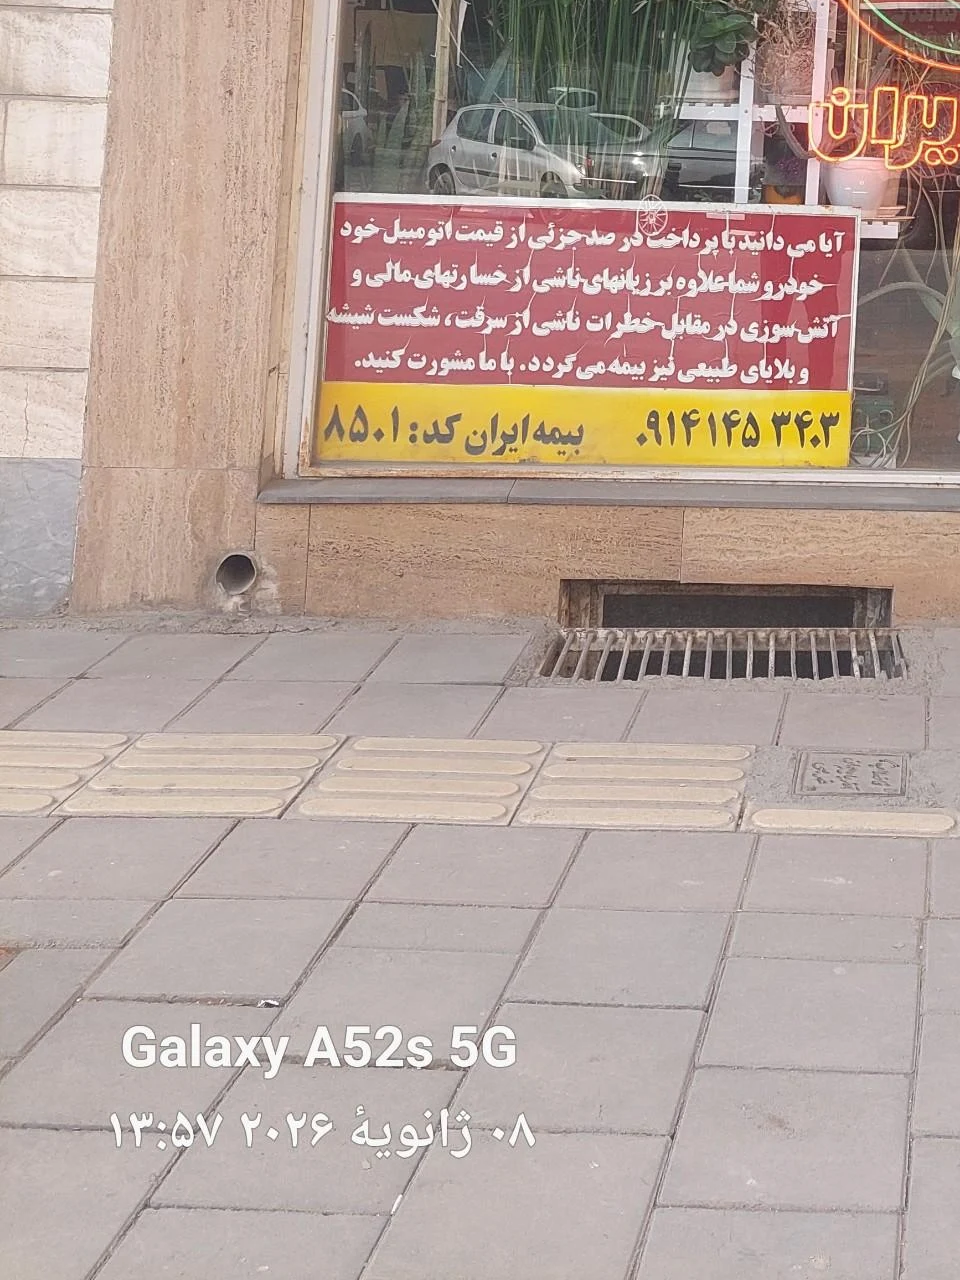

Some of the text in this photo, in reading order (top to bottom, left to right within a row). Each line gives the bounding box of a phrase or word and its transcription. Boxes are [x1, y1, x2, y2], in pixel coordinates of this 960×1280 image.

[339, 218, 381, 244] خود
[383, 217, 454, 249] اتومبیل
[454, 220, 504, 249] قیمت
[505, 218, 527, 250] از
[618, 229, 644, 253] در
[721, 226, 738, 256] با
[738, 228, 785, 257] دانید
[818, 230, 846, 258] آیا
[786, 237, 816, 258] می
[351, 267, 363, 287] و
[365, 259, 412, 288] مالی
[506, 265, 531, 293] از
[533, 265, 582, 294] ناشی
[675, 269, 729, 296] علاوه
[727, 268, 761, 294] شما
[326, 303, 375, 331] شیشه
[377, 303, 442, 329] شکست
[506, 309, 530, 337] از
[532, 308, 581, 337] ناشی
[661, 311, 711, 340] مقابل
[712, 317, 738, 342] در
[407, 349, 476, 377] مشورت
[479, 349, 497, 371] ما
[500, 350, 515, 375] با
[608, 357, 647, 381] بیمه
[648, 355, 676, 383] نیز
[677, 354, 738, 384] طبیعی
[740, 356, 796, 385] بلایای
[797, 366, 809, 385] و
[464, 412, 531, 457] ایران
[532, 420, 585, 456] بیمه
